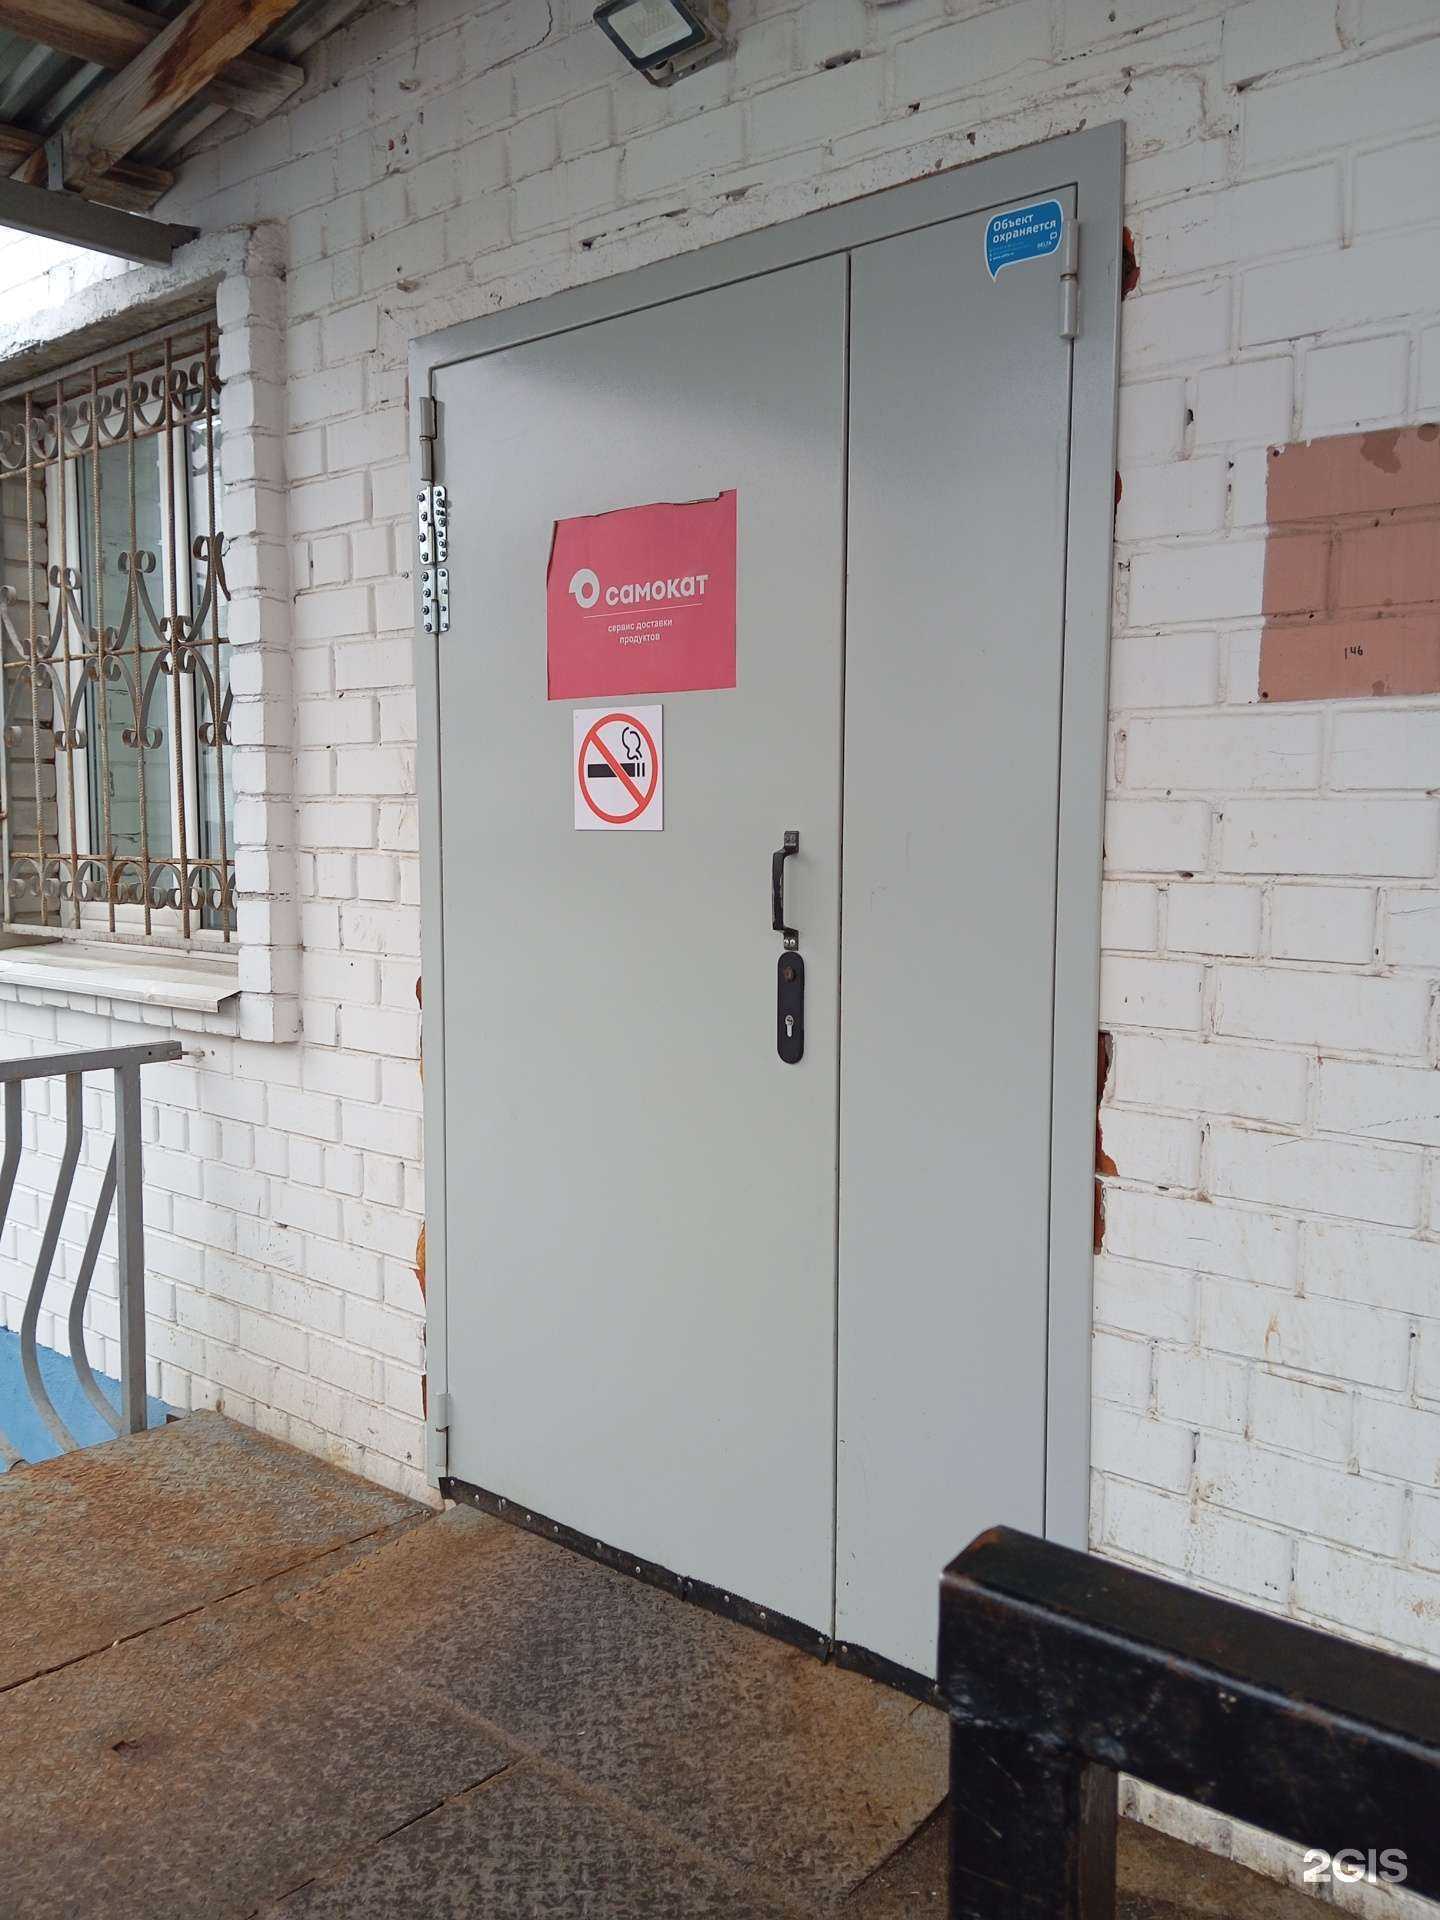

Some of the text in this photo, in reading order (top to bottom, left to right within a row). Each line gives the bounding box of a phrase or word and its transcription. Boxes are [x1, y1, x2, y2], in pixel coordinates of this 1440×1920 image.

[993, 215, 1034, 232] Объект
[993, 220, 1057, 243] охраняется
[605, 574, 709, 606] самокат
[608, 618, 673, 633] сервис доставки
[619, 632, 661, 645] продуктов
